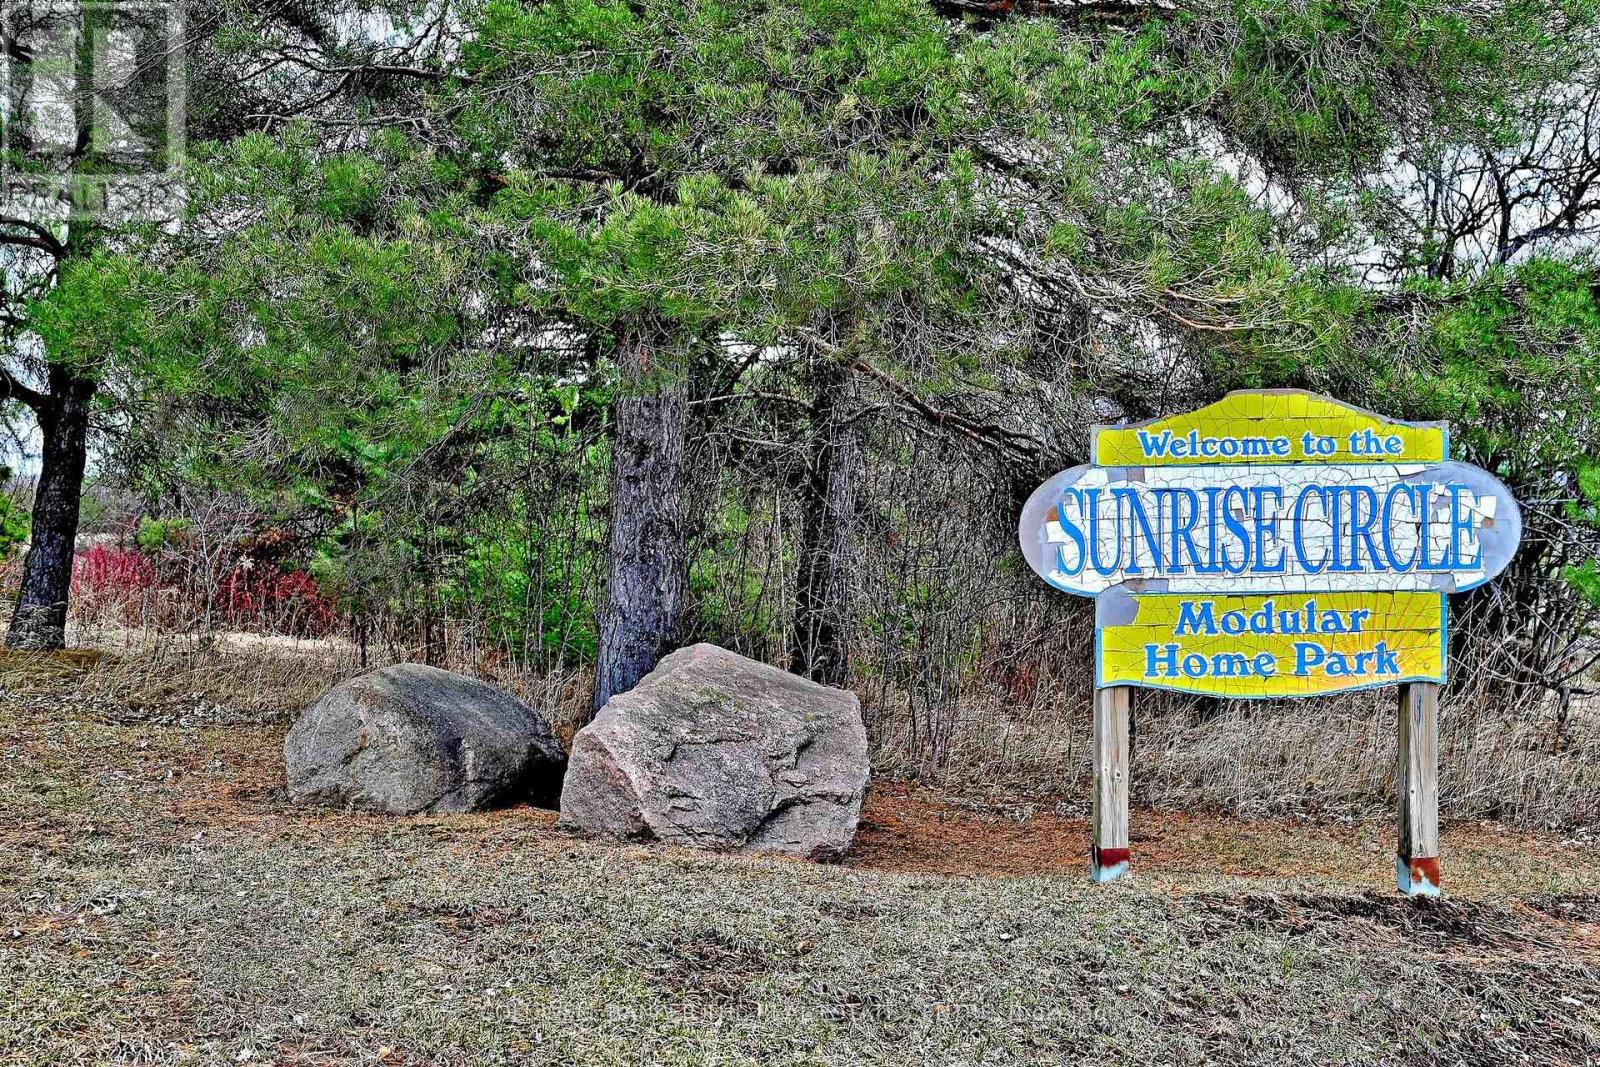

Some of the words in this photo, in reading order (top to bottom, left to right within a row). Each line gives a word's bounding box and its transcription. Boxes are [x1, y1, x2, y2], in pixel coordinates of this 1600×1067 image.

[1137, 430, 1289, 457] Welcome
[1303, 431, 1336, 456] to
[1349, 429, 1402, 454] the
[1056, 483, 1286, 577] SUNRISE
[1292, 482, 1483, 574] CIRCLE
[1175, 599, 1371, 637] Modular
[1144, 644, 1276, 679] Home
[1295, 642, 1401, 677] Park
